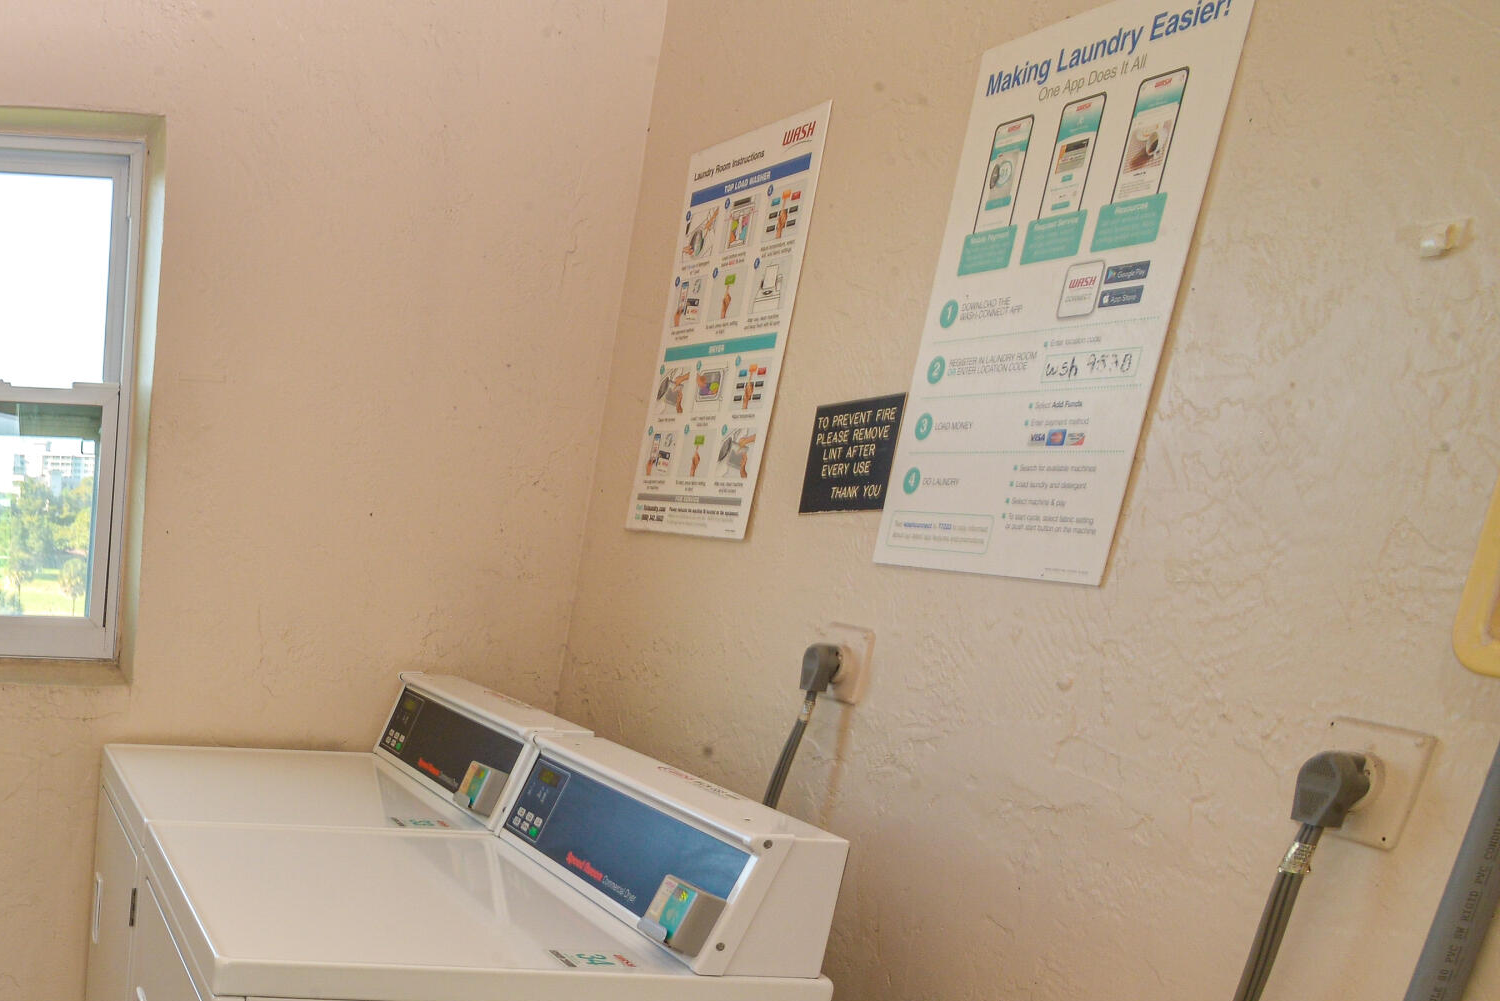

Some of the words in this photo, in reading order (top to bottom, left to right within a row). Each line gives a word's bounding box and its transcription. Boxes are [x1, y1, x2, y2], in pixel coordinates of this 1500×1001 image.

[986, 59, 1051, 96] Making
[1057, 26, 1144, 72] Laundry
[1150, 0, 1232, 41] Easier!
[1038, 86, 1060, 102] One
[1063, 77, 1085, 96] App
[1088, 65, 1117, 86] Does
[1120, 61, 1128, 75] It
[1130, 54, 1148, 71] All
[782, 121, 817, 146] WASH
[694, 166, 715, 182] Laundry
[715, 160, 732, 175] Room
[732, 150, 765, 169] Instructions
[724, 184, 735, 194] TOP
[734, 178, 749, 192] LOAD
[749, 171, 771, 187] WASHER
[1068, 276, 1098, 289] WASH
[962, 299, 998, 312] DOWNLOAD
[999, 296, 1012, 306] THE
[985, 354, 1016, 365] LAUNDRY
[1016, 351, 1038, 361] ROOM
[956, 367, 978, 376] ENTER
[978, 363, 1009, 375] LOCATION
[1051, 400, 1064, 409] Add
[1065, 400, 1083, 409] Funds
[818, 417, 829, 430] TO
[832, 410, 873, 427] PREVENT
[876, 407, 897, 422] FIRE
[934, 422, 950, 432] LOAD
[950, 421, 973, 431] MONEY
[816, 430, 850, 445] PLEASE
[853, 425, 890, 441] REMOVE
[1030, 433, 1046, 442] VISA
[823, 446, 843, 460] LINT
[846, 443, 876, 458] AFTER
[822, 463, 850, 477] EVERY
[853, 461, 871, 474] USE
[1020, 464, 1037, 472] Search
[932, 477, 960, 487] LAUNDRY
[1015, 481, 1028, 489] Load
[831, 486, 860, 499] THANK
[863, 484, 881, 497] YOU
[1011, 497, 1027, 505] Select
[1072, 527, 1097, 536] machine
[1458, 888, 1480, 922] RIGID
[1473, 864, 1488, 884] PVC
[575, 953, 616, 966] 34
[1443, 943, 1459, 964] PVC
